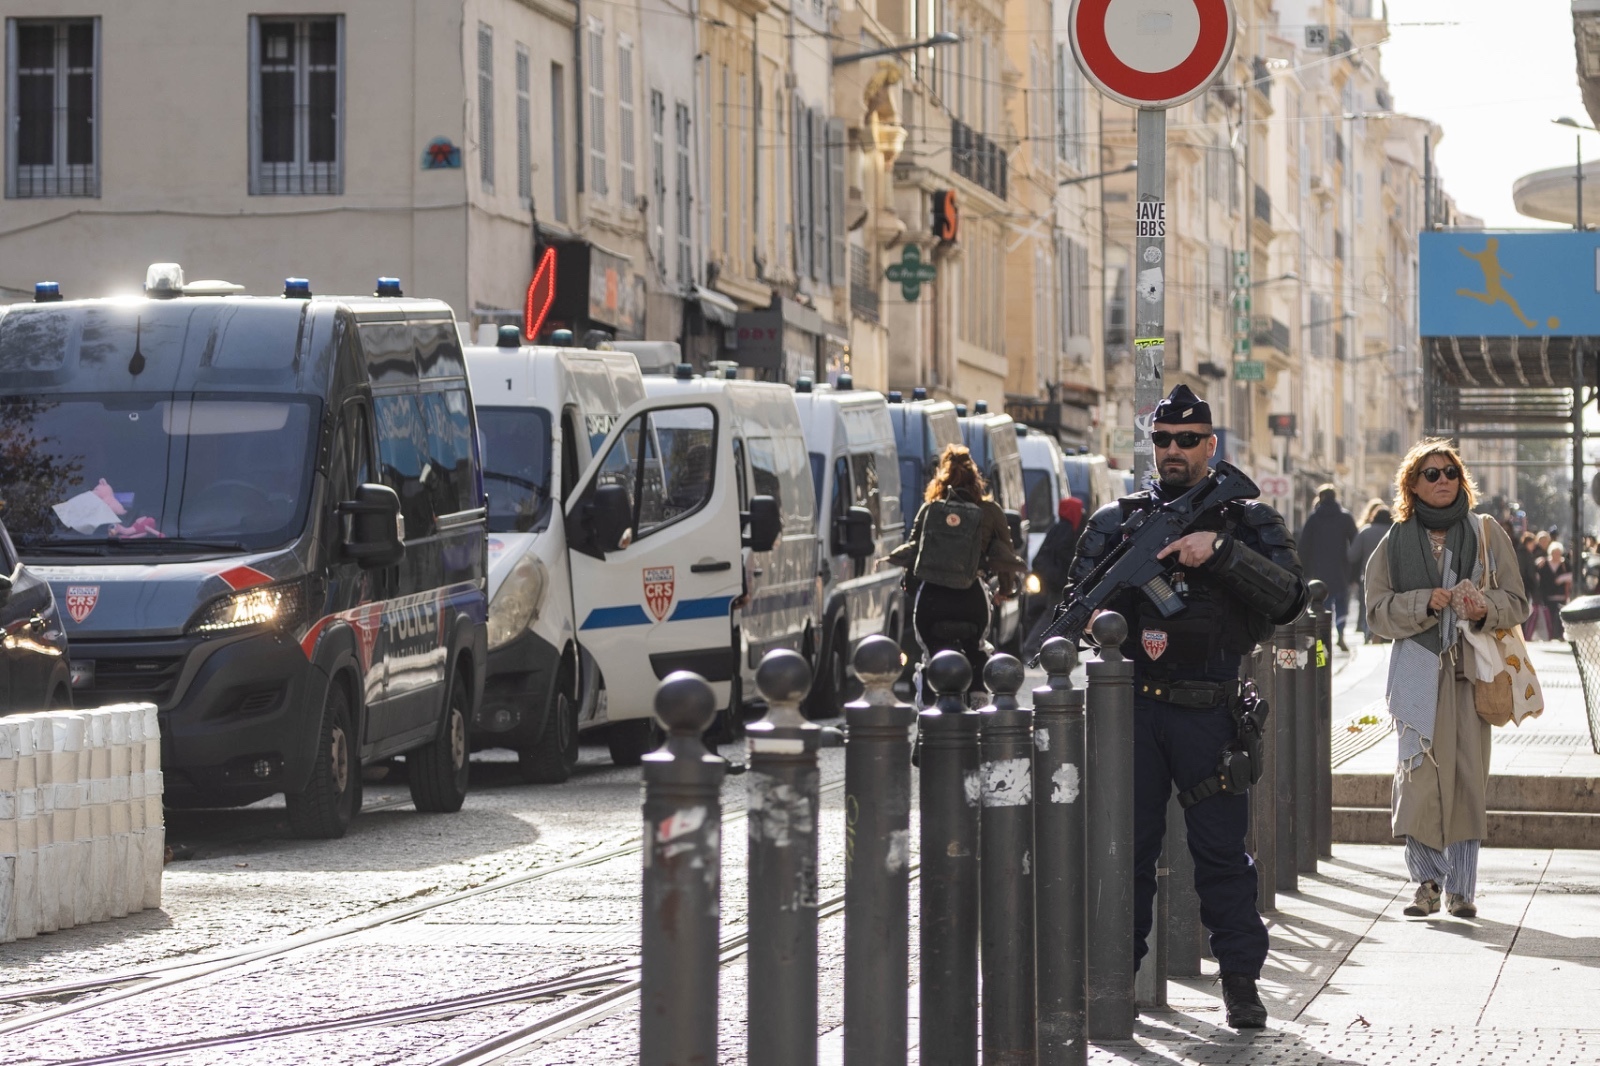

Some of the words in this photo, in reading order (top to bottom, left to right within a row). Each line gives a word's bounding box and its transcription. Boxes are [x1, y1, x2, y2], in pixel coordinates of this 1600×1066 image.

[1310, 29, 1325, 43] 25
[1233, 250, 1250, 354] HOTEL
[505, 378, 512, 390] 1
[645, 583, 673, 598] CRS
[68, 596, 95, 606] CRS
[386, 600, 435, 643] POLICE
[1145, 640, 1165, 648] CRS
